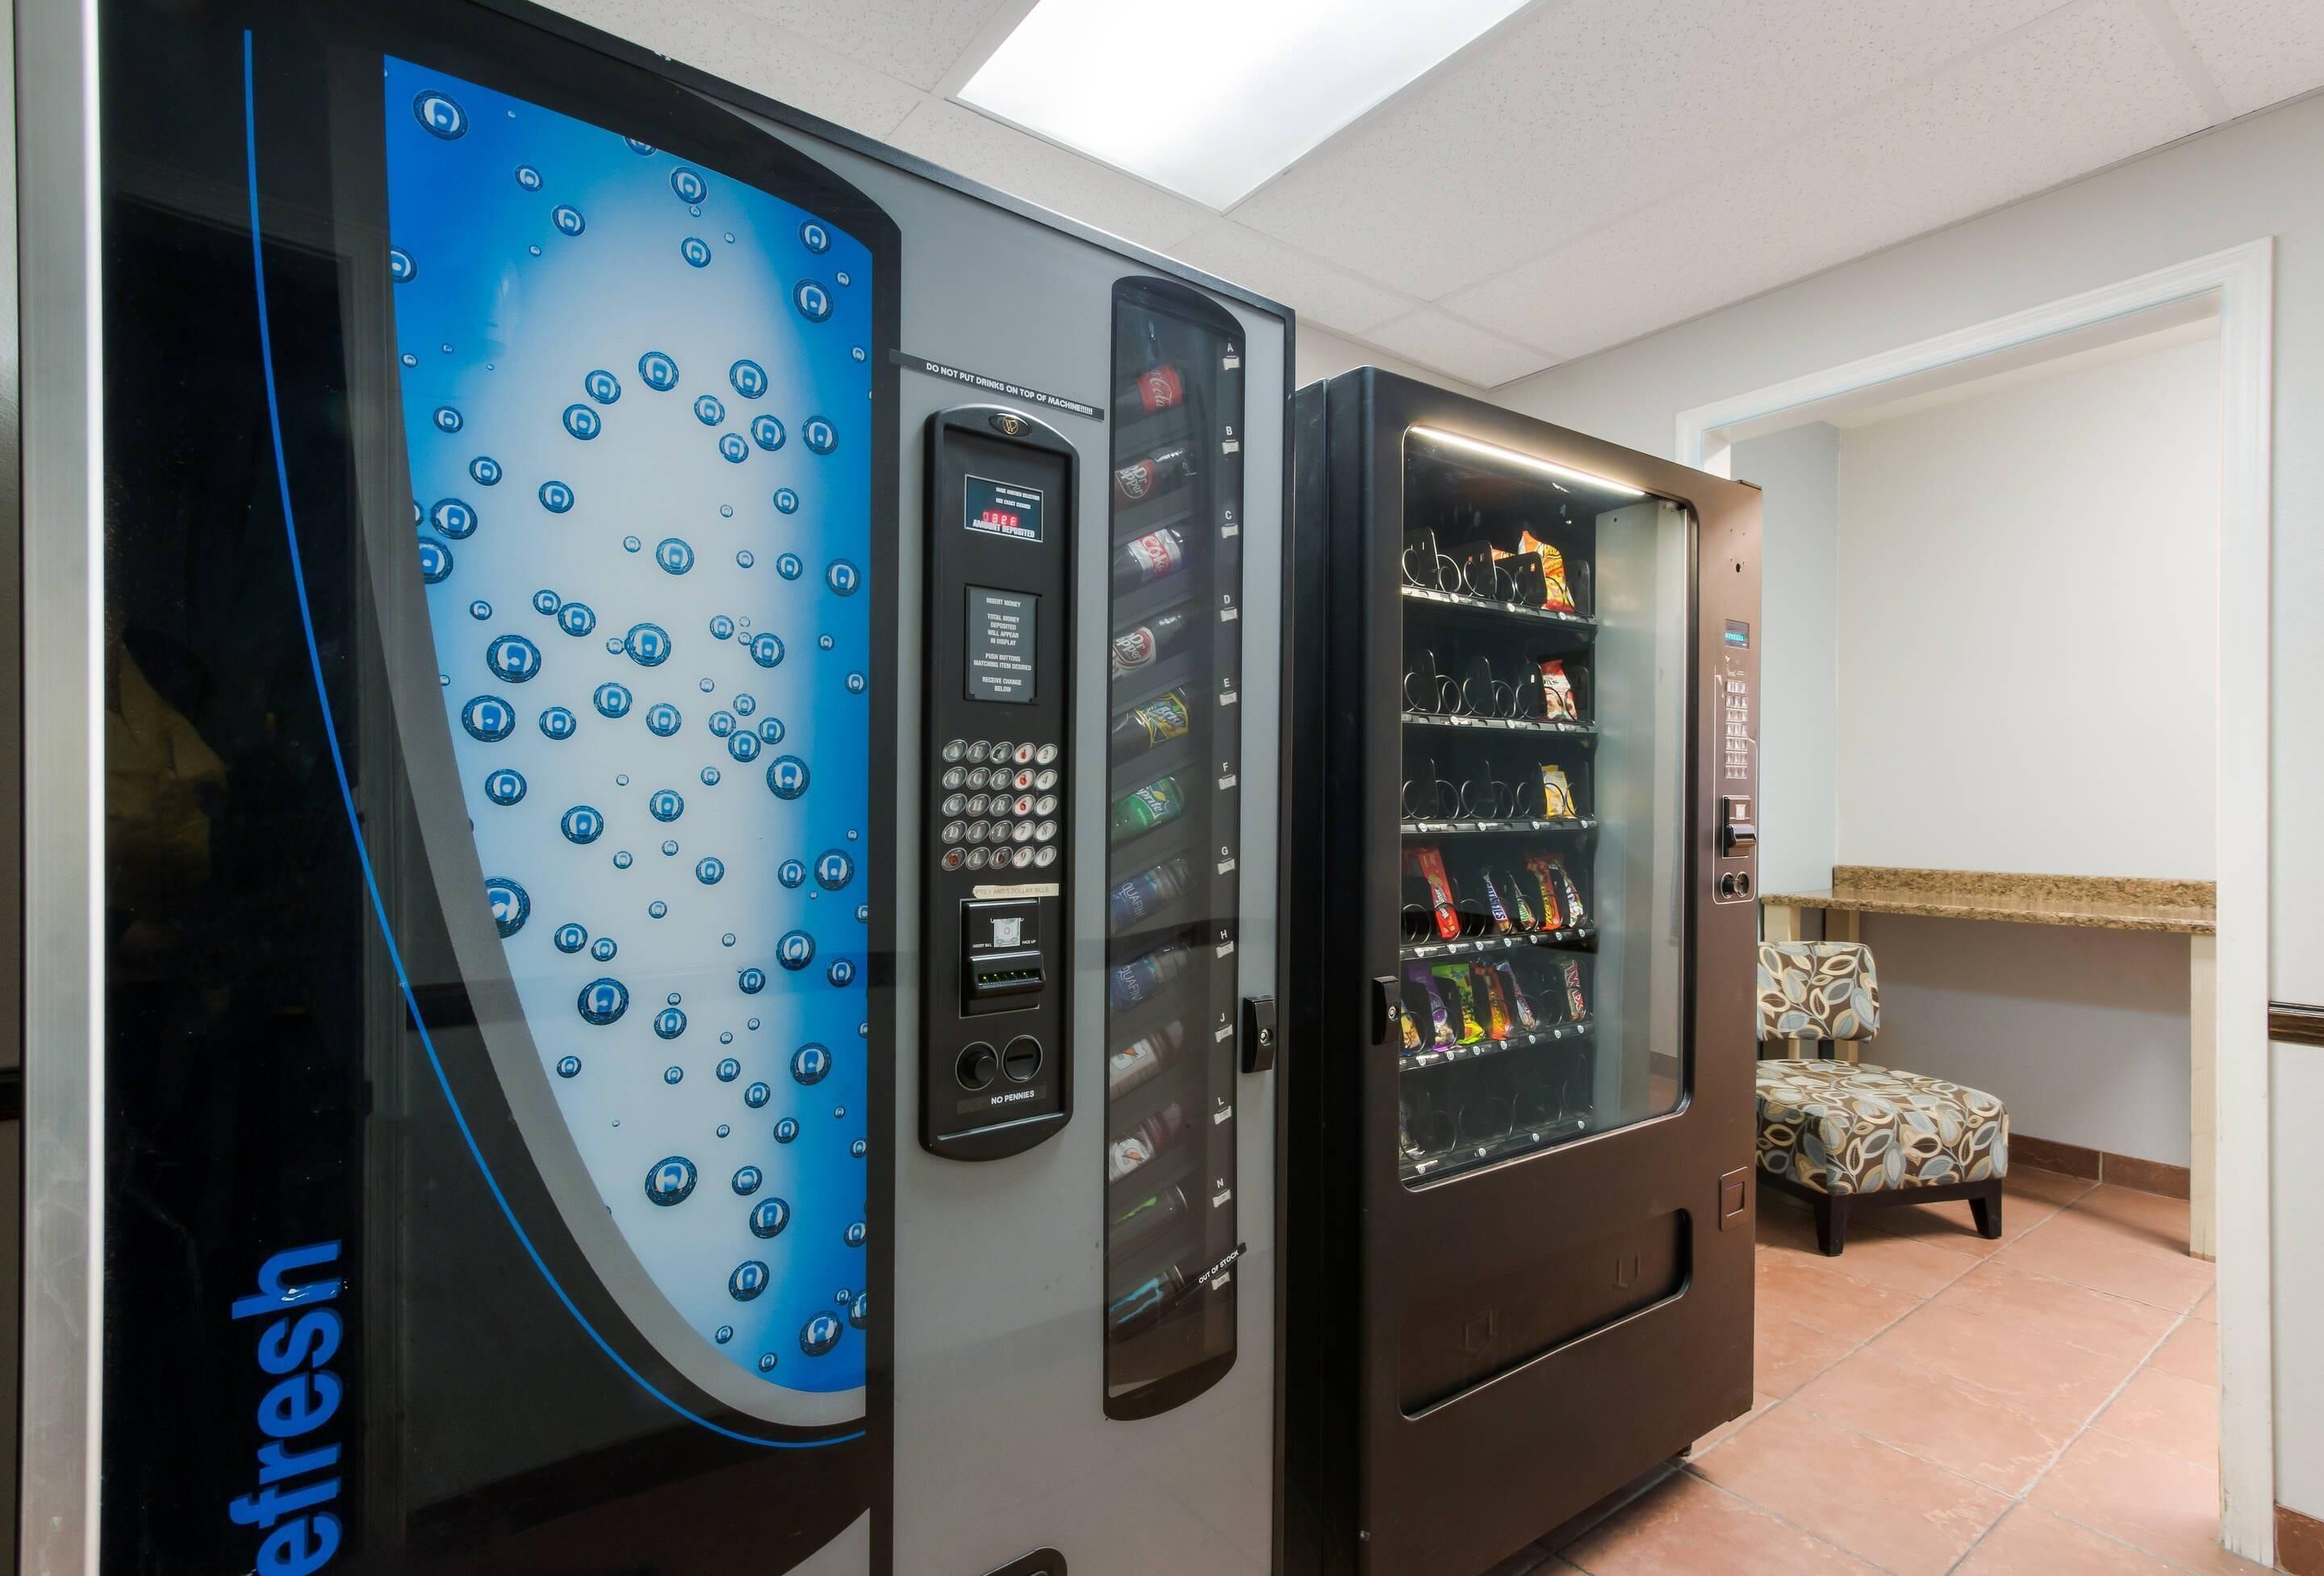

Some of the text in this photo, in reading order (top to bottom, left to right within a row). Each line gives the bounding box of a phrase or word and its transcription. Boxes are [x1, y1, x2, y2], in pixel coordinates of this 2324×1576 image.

[1227, 342, 1234, 352] A
[926, 362, 939, 373] DO
[940, 366, 959, 379] NOT
[959, 372, 975, 383] PUT
[976, 376, 1005, 391] DRINKS
[1005, 385, 1018, 395] ON
[1019, 388, 1035, 399] TOP
[1036, 393, 1047, 403] OF
[1225, 426, 1233, 436] B
[1225, 510, 1232, 520] C
[972, 519, 1001, 532] AMOUNT
[1001, 525, 1035, 538] DEPOSITED
[986, 597, 1021, 608] INSERT MONEY
[1223, 594, 1231, 604] D
[987, 613, 1020, 623] TOTAL MONEY
[990, 621, 1017, 630] DEPOSITED
[1000, 631, 1019, 639] APPEAR
[997, 638, 1017, 646] DISPLAY
[999, 654, 1021, 662] BUTTONS
[973, 659, 999, 668] MATCHING
[1012, 663, 1032, 671] DESIRED
[1002, 678, 1022, 686] CHANGE
[1223, 678, 1231, 688] E
[1223, 762, 1229, 771] F
[1221, 846, 1229, 855] G
[1122, 882, 1146, 918] QUAFIN
[1220, 929, 1227, 940] H
[1118, 962, 1143, 1001] QUAFIN
[1220, 1013, 1226, 1022] J
[991, 1089, 1035, 1105] NO PENNIES
[1218, 1097, 1224, 1106] L
[1216, 1177, 1224, 1189] N
[1198, 1249, 1239, 1285] OUT OF STOCK
